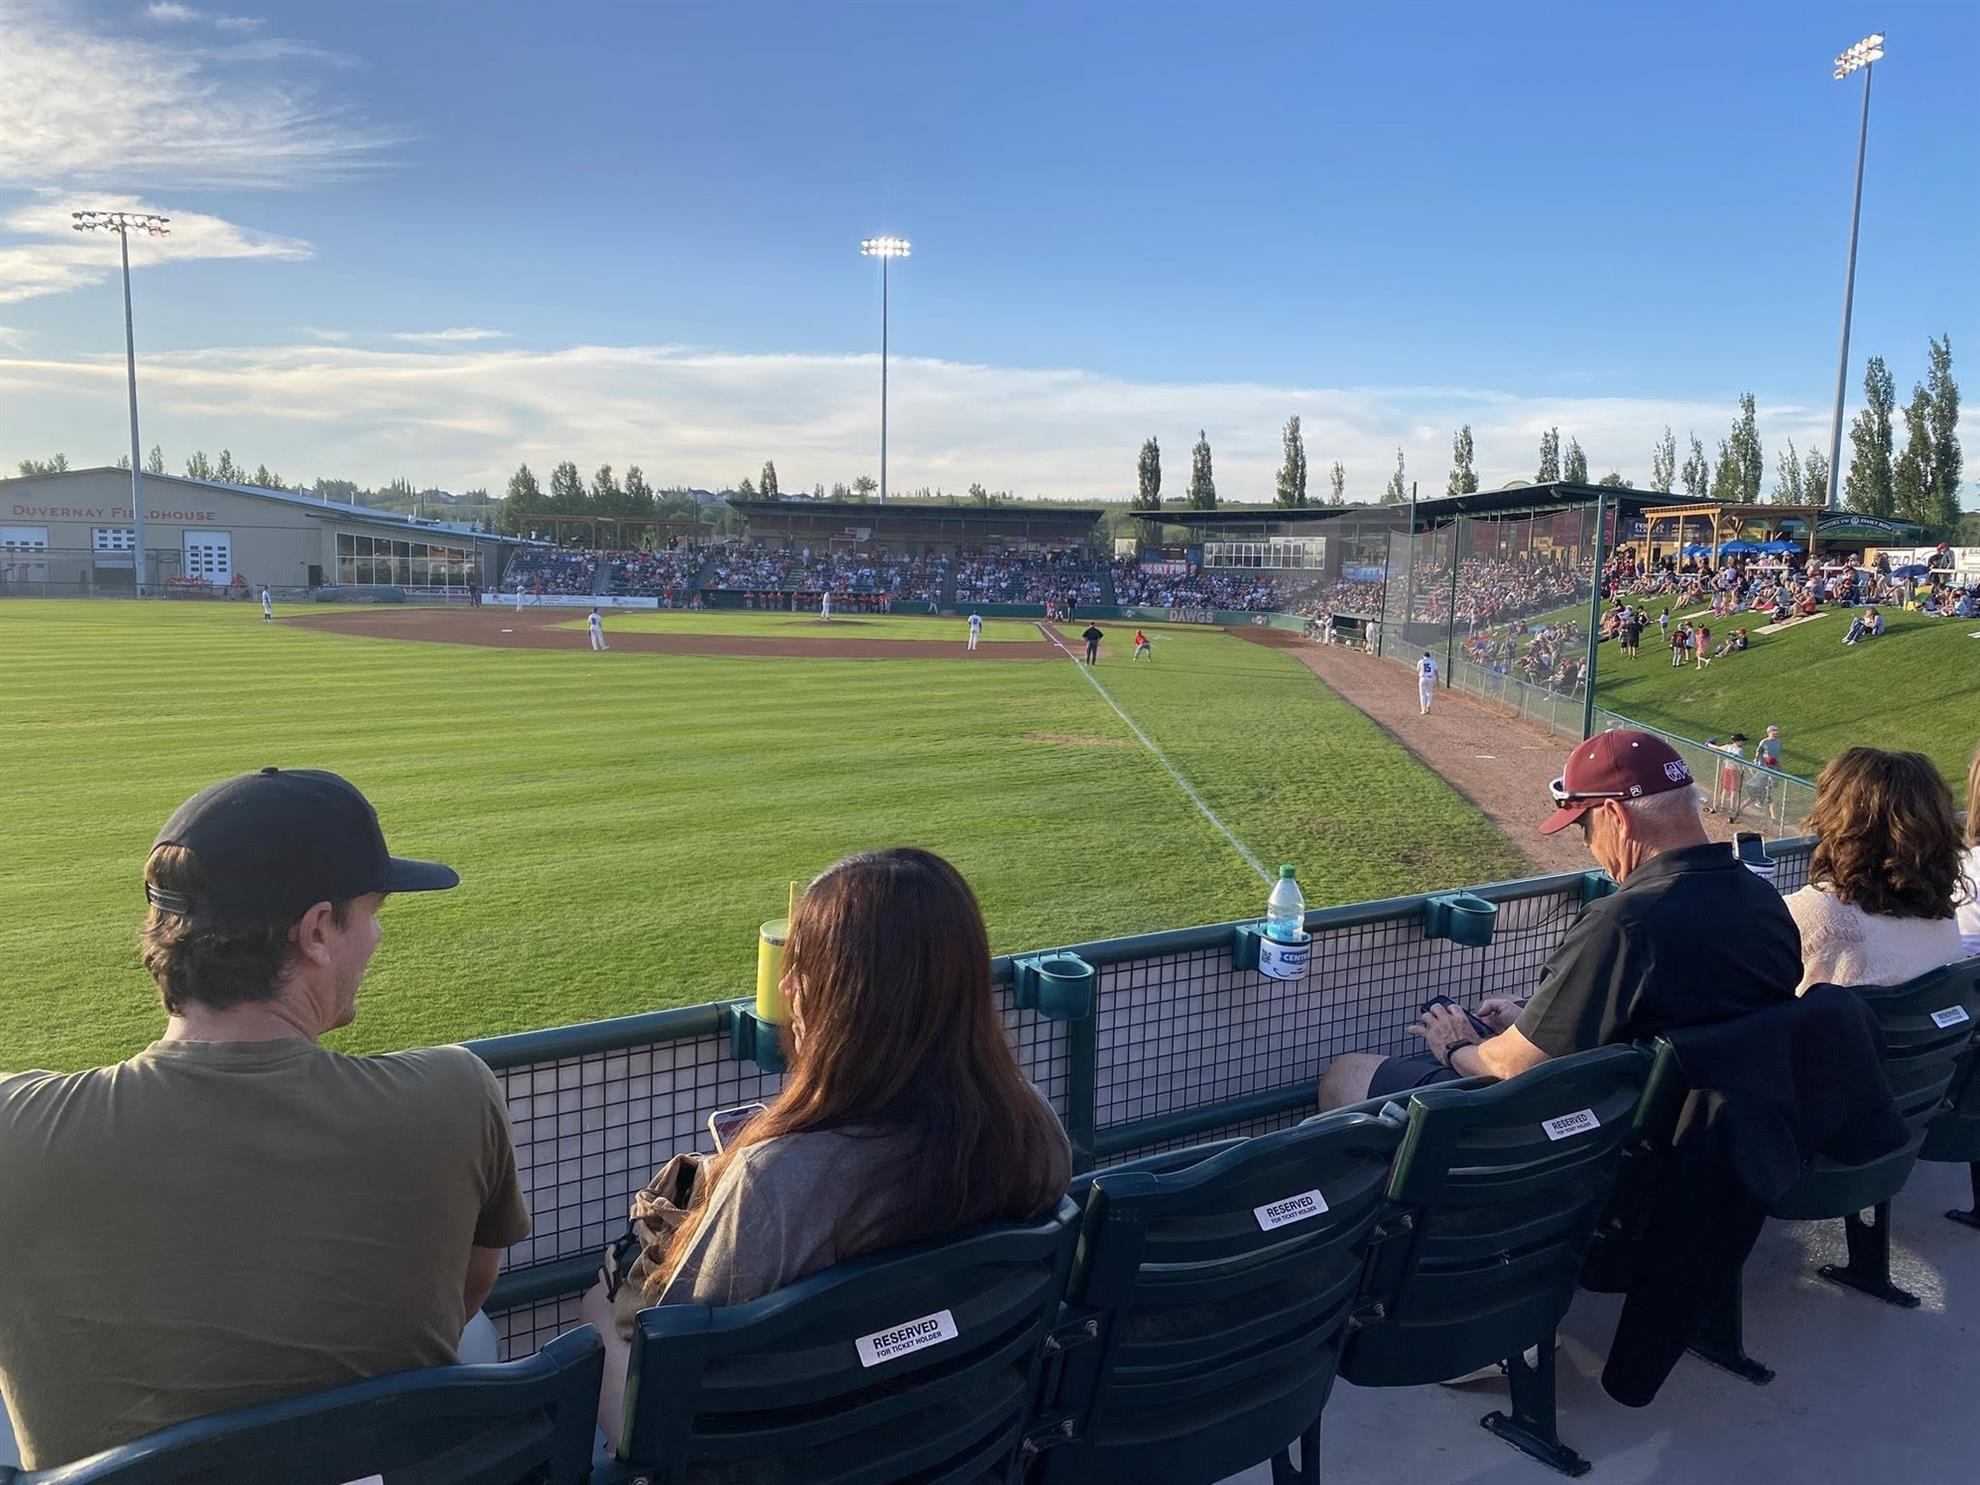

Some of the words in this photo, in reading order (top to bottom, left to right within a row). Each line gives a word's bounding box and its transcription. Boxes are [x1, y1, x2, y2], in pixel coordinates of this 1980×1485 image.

[12, 505, 104, 518] DUVERNAY
[1860, 518, 1878, 526] FAMILY
[1169, 609, 1214, 624] DAWGS
[1423, 663, 1432, 673] 15
[1551, 1114, 1588, 1131] RESERVED
[1266, 1196, 1314, 1218] RESERVED
[1270, 1216, 1283, 1224] FOR
[1281, 1211, 1298, 1221] TICKET
[1298, 1205, 1317, 1215] HOLDER
[872, 1319, 938, 1350] RESERVED
[876, 1348, 891, 1358] FOR
[891, 1340, 915, 1354] TICKET
[915, 1330, 943, 1345] HOLDER
